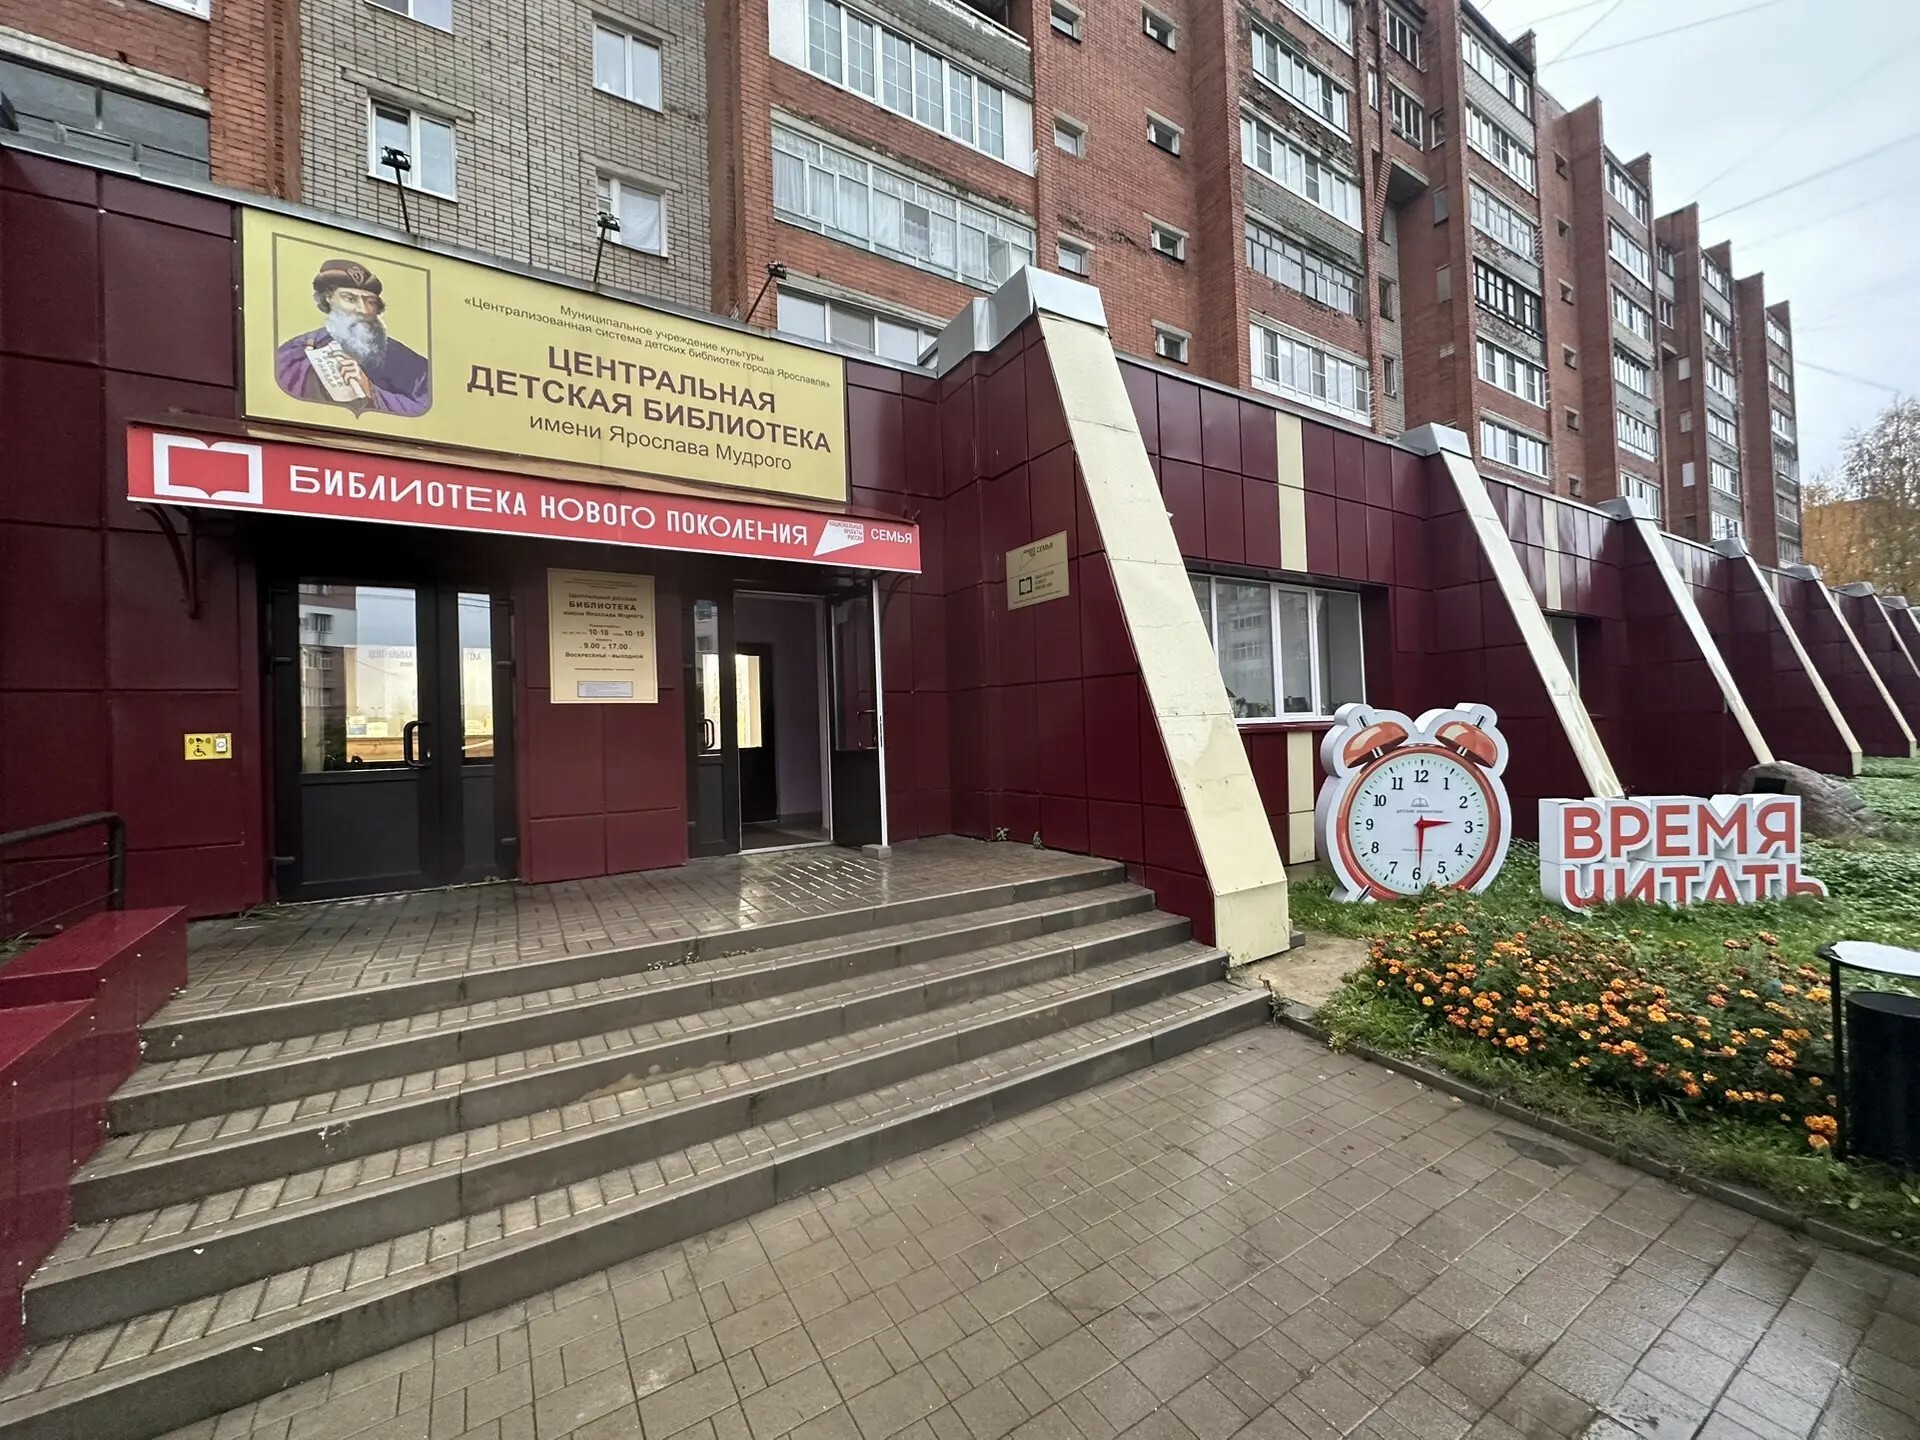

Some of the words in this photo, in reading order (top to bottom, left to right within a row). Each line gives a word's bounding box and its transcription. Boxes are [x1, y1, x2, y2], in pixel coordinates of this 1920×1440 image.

[560, 305, 652, 336] Муниципальное
[655, 330, 717, 351] учреждение
[720, 346, 764, 363] культуры
[464, 296, 592, 333] «Централизованная
[595, 327, 642, 345] система
[645, 340, 686, 355] детских
[688, 349, 740, 367] библиотек
[742, 363, 775, 376] города
[777, 368, 830, 387] Ярославля»
[548, 345, 775, 413] ЦЕНТРАЛЬНАЯ
[466, 364, 632, 417] ДЕТСКАЯ
[643, 398, 831, 453] БИБЛИОТЕКА
[530, 415, 602, 440] имени
[609, 425, 709, 457] Ярослава
[716, 443, 792, 470] Мудрого
[289, 464, 527, 516] БИБЛИОТЕКА
[540, 494, 656, 531] НОВОГО
[666, 509, 808, 546] ПОКОЛЕНИЯ
[870, 528, 913, 544] СЕМЬЯ
[568, 600, 637, 611] БИБЛИОТЕКА
[1413, 769, 1429, 783] 12
[1391, 777, 1404, 790] 11
[1442, 777, 1451, 790] 1
[1373, 794, 1387, 807] 10
[1459, 796, 1469, 809] 2
[1365, 818, 1374, 831] 9
[1464, 820, 1474, 833] 3
[1563, 802, 1796, 859] ВРЕМЯ
[1371, 841, 1380, 854] 8
[1454, 842, 1464, 856] 4
[1388, 861, 1398, 875] 7
[1412, 867, 1421, 880] 6
[1437, 861, 1446, 874] 5
[1564, 863, 1825, 910] ЧИТАТЬ
